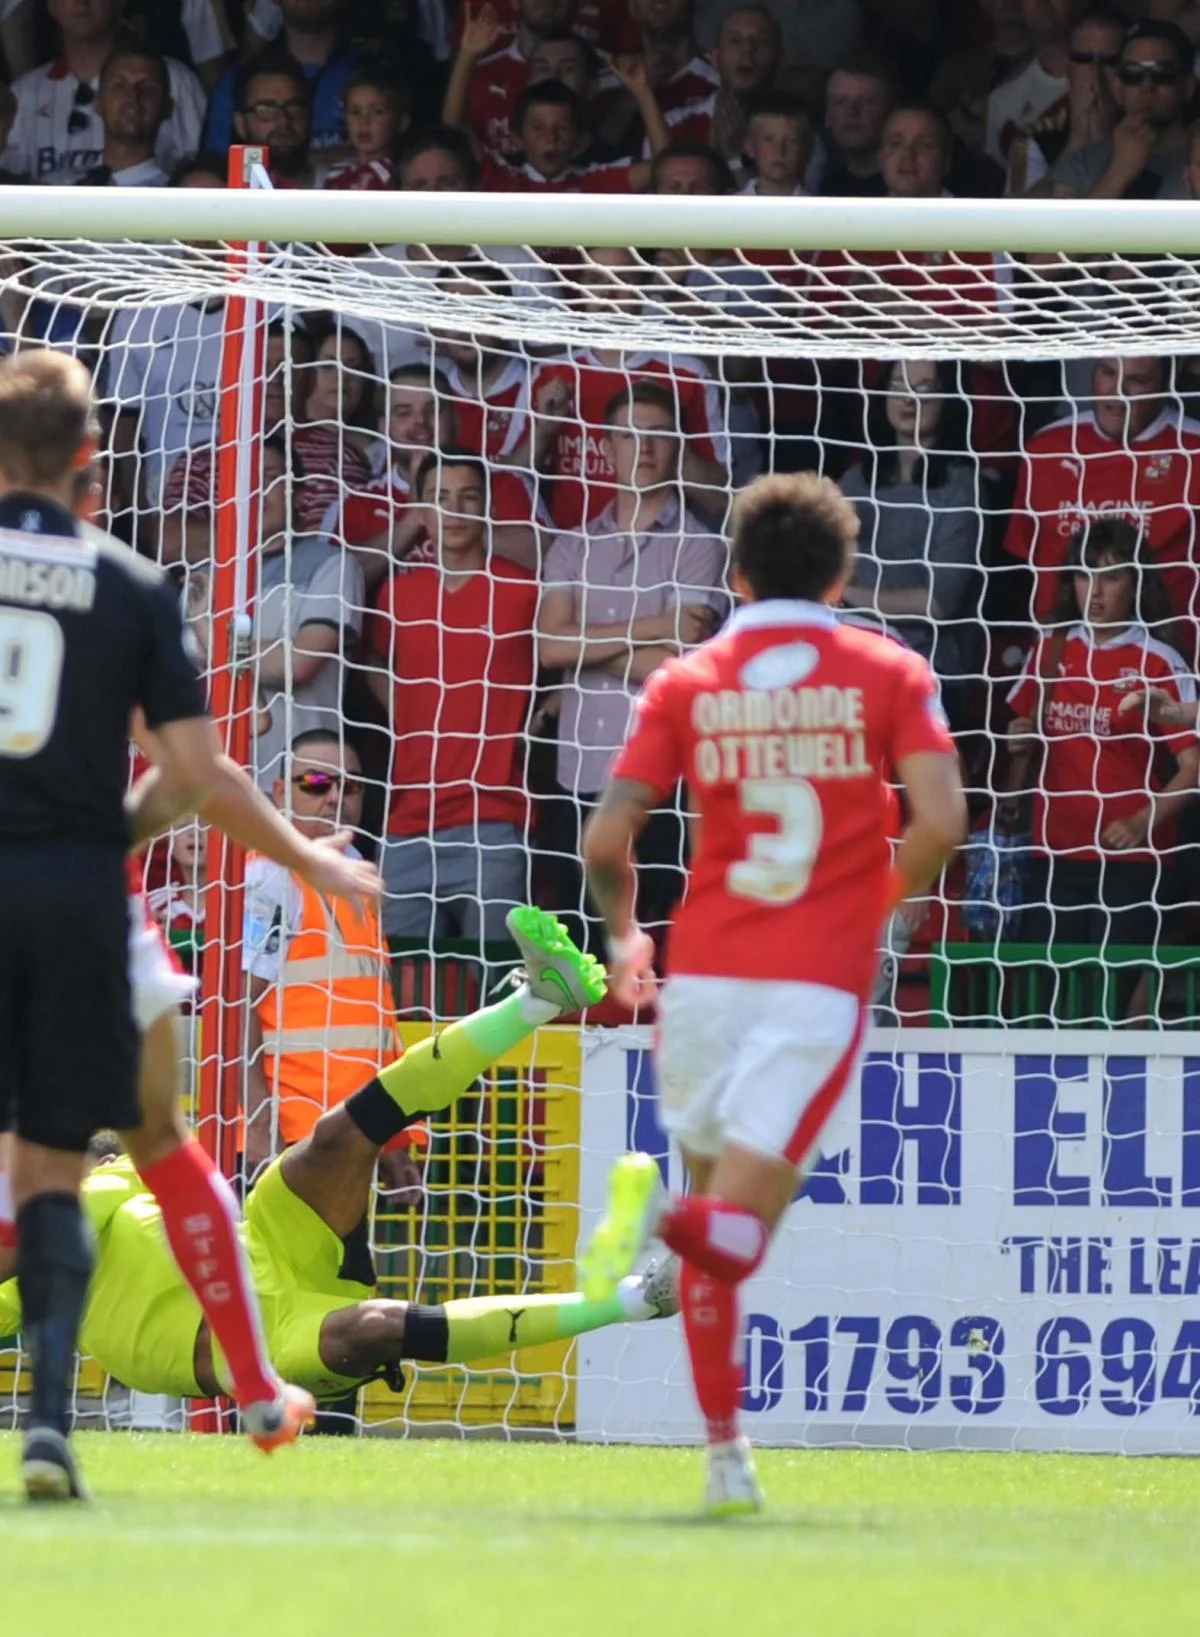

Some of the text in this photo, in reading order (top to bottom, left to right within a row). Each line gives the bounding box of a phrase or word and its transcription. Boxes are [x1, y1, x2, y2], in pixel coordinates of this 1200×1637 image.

[691, 683, 866, 735] ORMONDE
[693, 729, 875, 786] OTTEWELL
[724, 776, 824, 907] 3
[739, 1312, 1200, 1417] 01793 694
